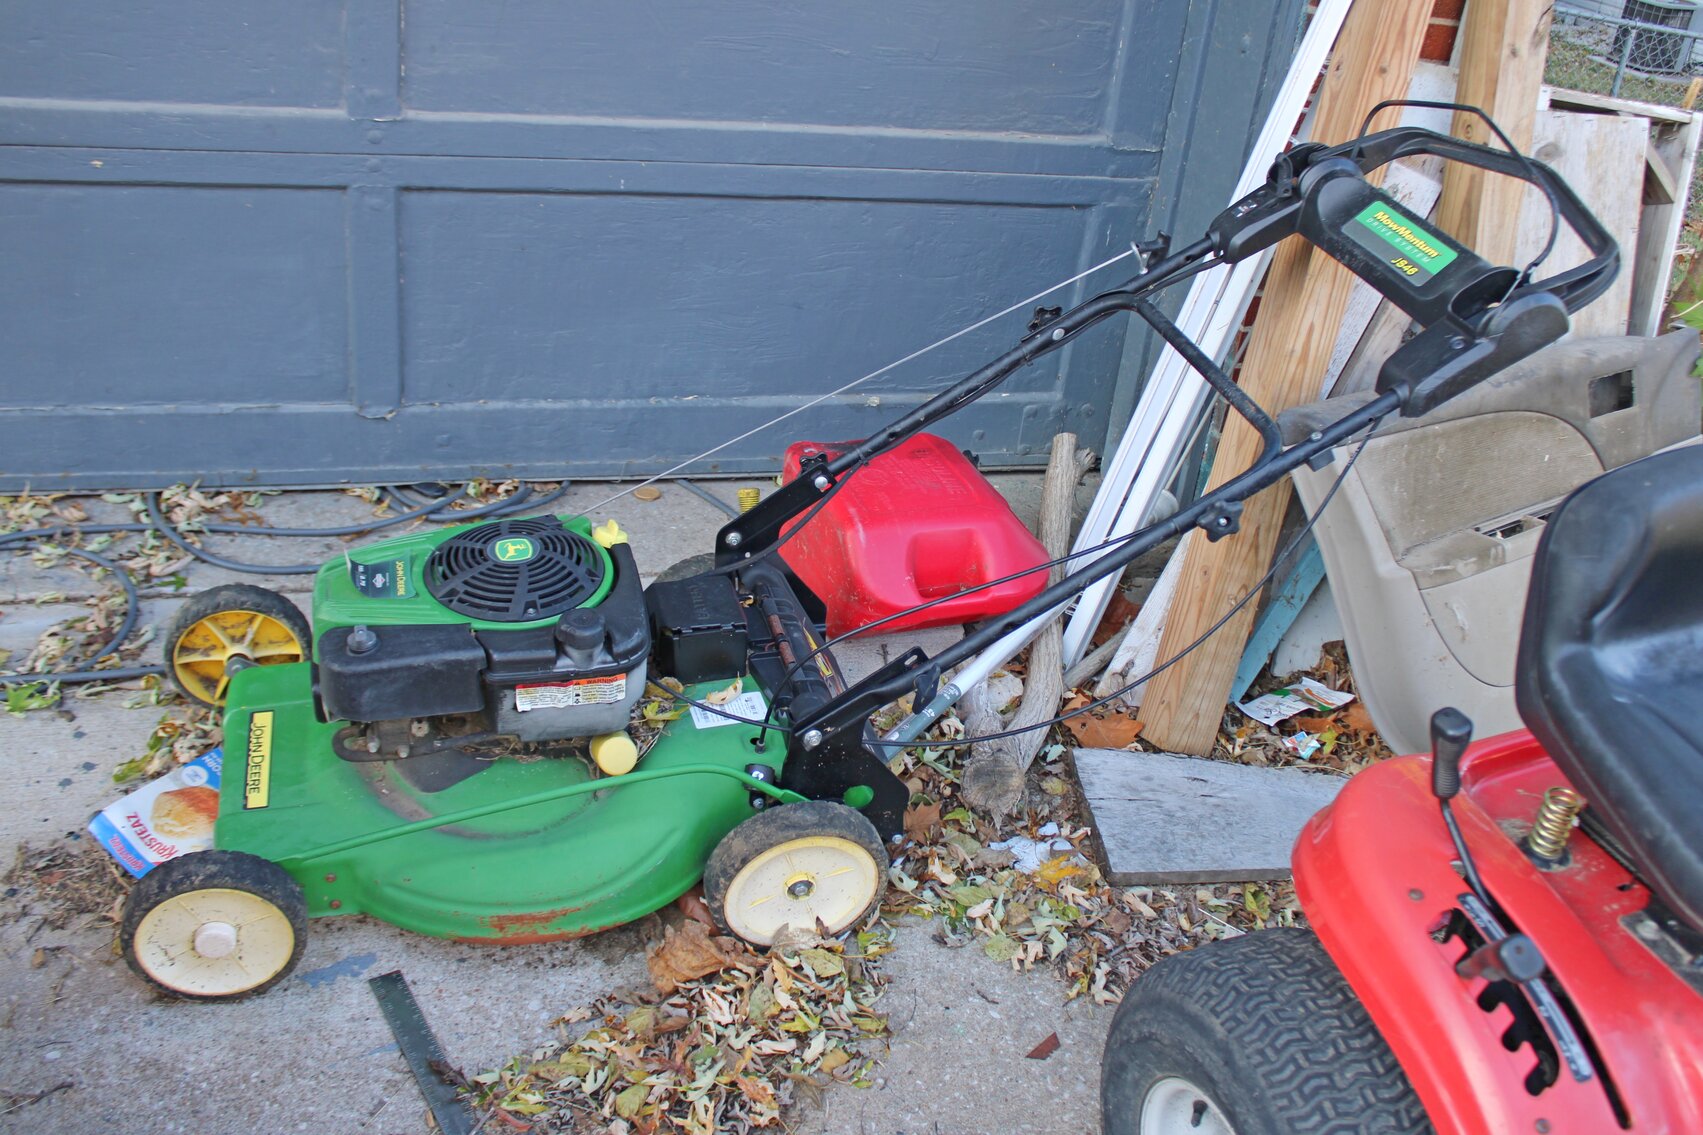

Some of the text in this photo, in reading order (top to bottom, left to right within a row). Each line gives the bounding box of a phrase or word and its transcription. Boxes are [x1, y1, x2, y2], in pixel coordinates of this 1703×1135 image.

[1366, 218, 1432, 263] DRIVE SYSTEM
[395, 560, 406, 596] JOHN DEERE
[586, 677, 618, 685] WARNING
[248, 722, 267, 794] JOHN DEERE
[109, 833, 146, 871] KRUSTEAZ
[126, 811, 179, 859] KRUSTEAZ
